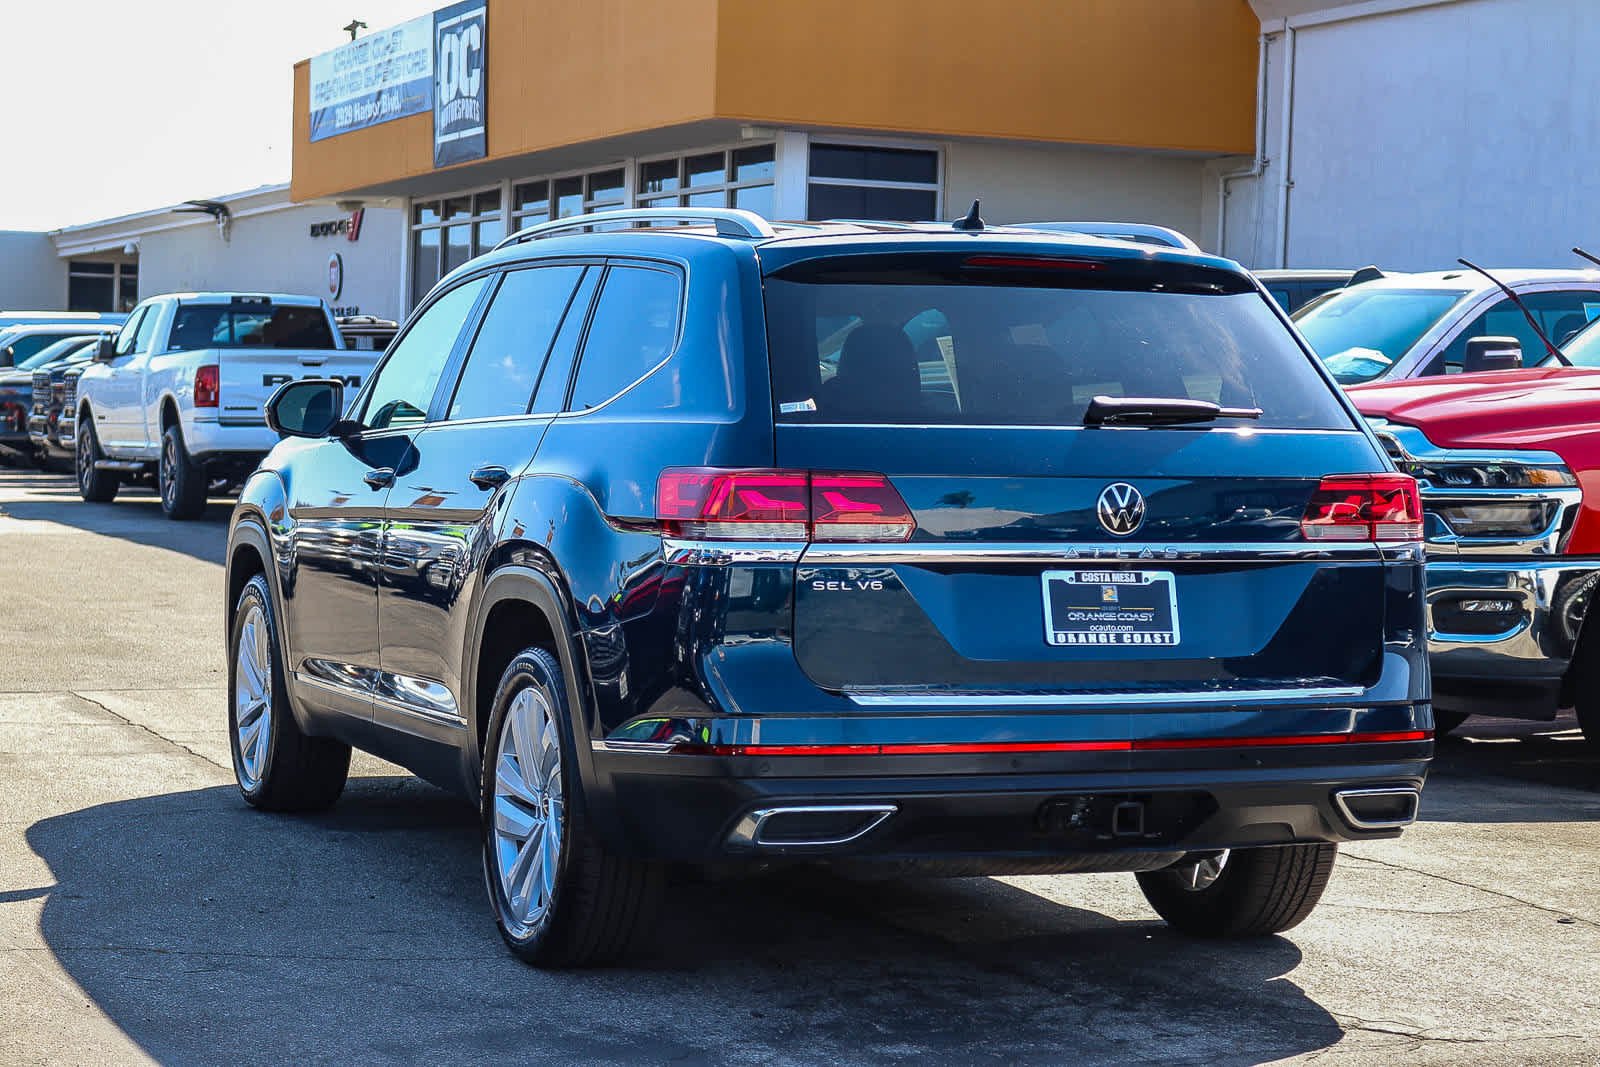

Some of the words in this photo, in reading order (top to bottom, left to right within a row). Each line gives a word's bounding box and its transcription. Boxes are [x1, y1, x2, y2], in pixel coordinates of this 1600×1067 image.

[440, 24, 481, 106] OC
[440, 97, 480, 131] MOTORSPORTS
[263, 374, 362, 388] RM
[1063, 546, 1179, 559] ATLAS
[1081, 572, 1112, 583] COSTA
[1112, 573, 1136, 583] MESA
[812, 580, 852, 591] SEL
[857, 580, 883, 591] V6
[1067, 611, 1117, 622] ORANGE
[1117, 612, 1154, 622] COAST
[1089, 624, 1134, 632] ocauto.com
[1057, 633, 1117, 643] ORANGE
[1123, 633, 1171, 644] COAST
